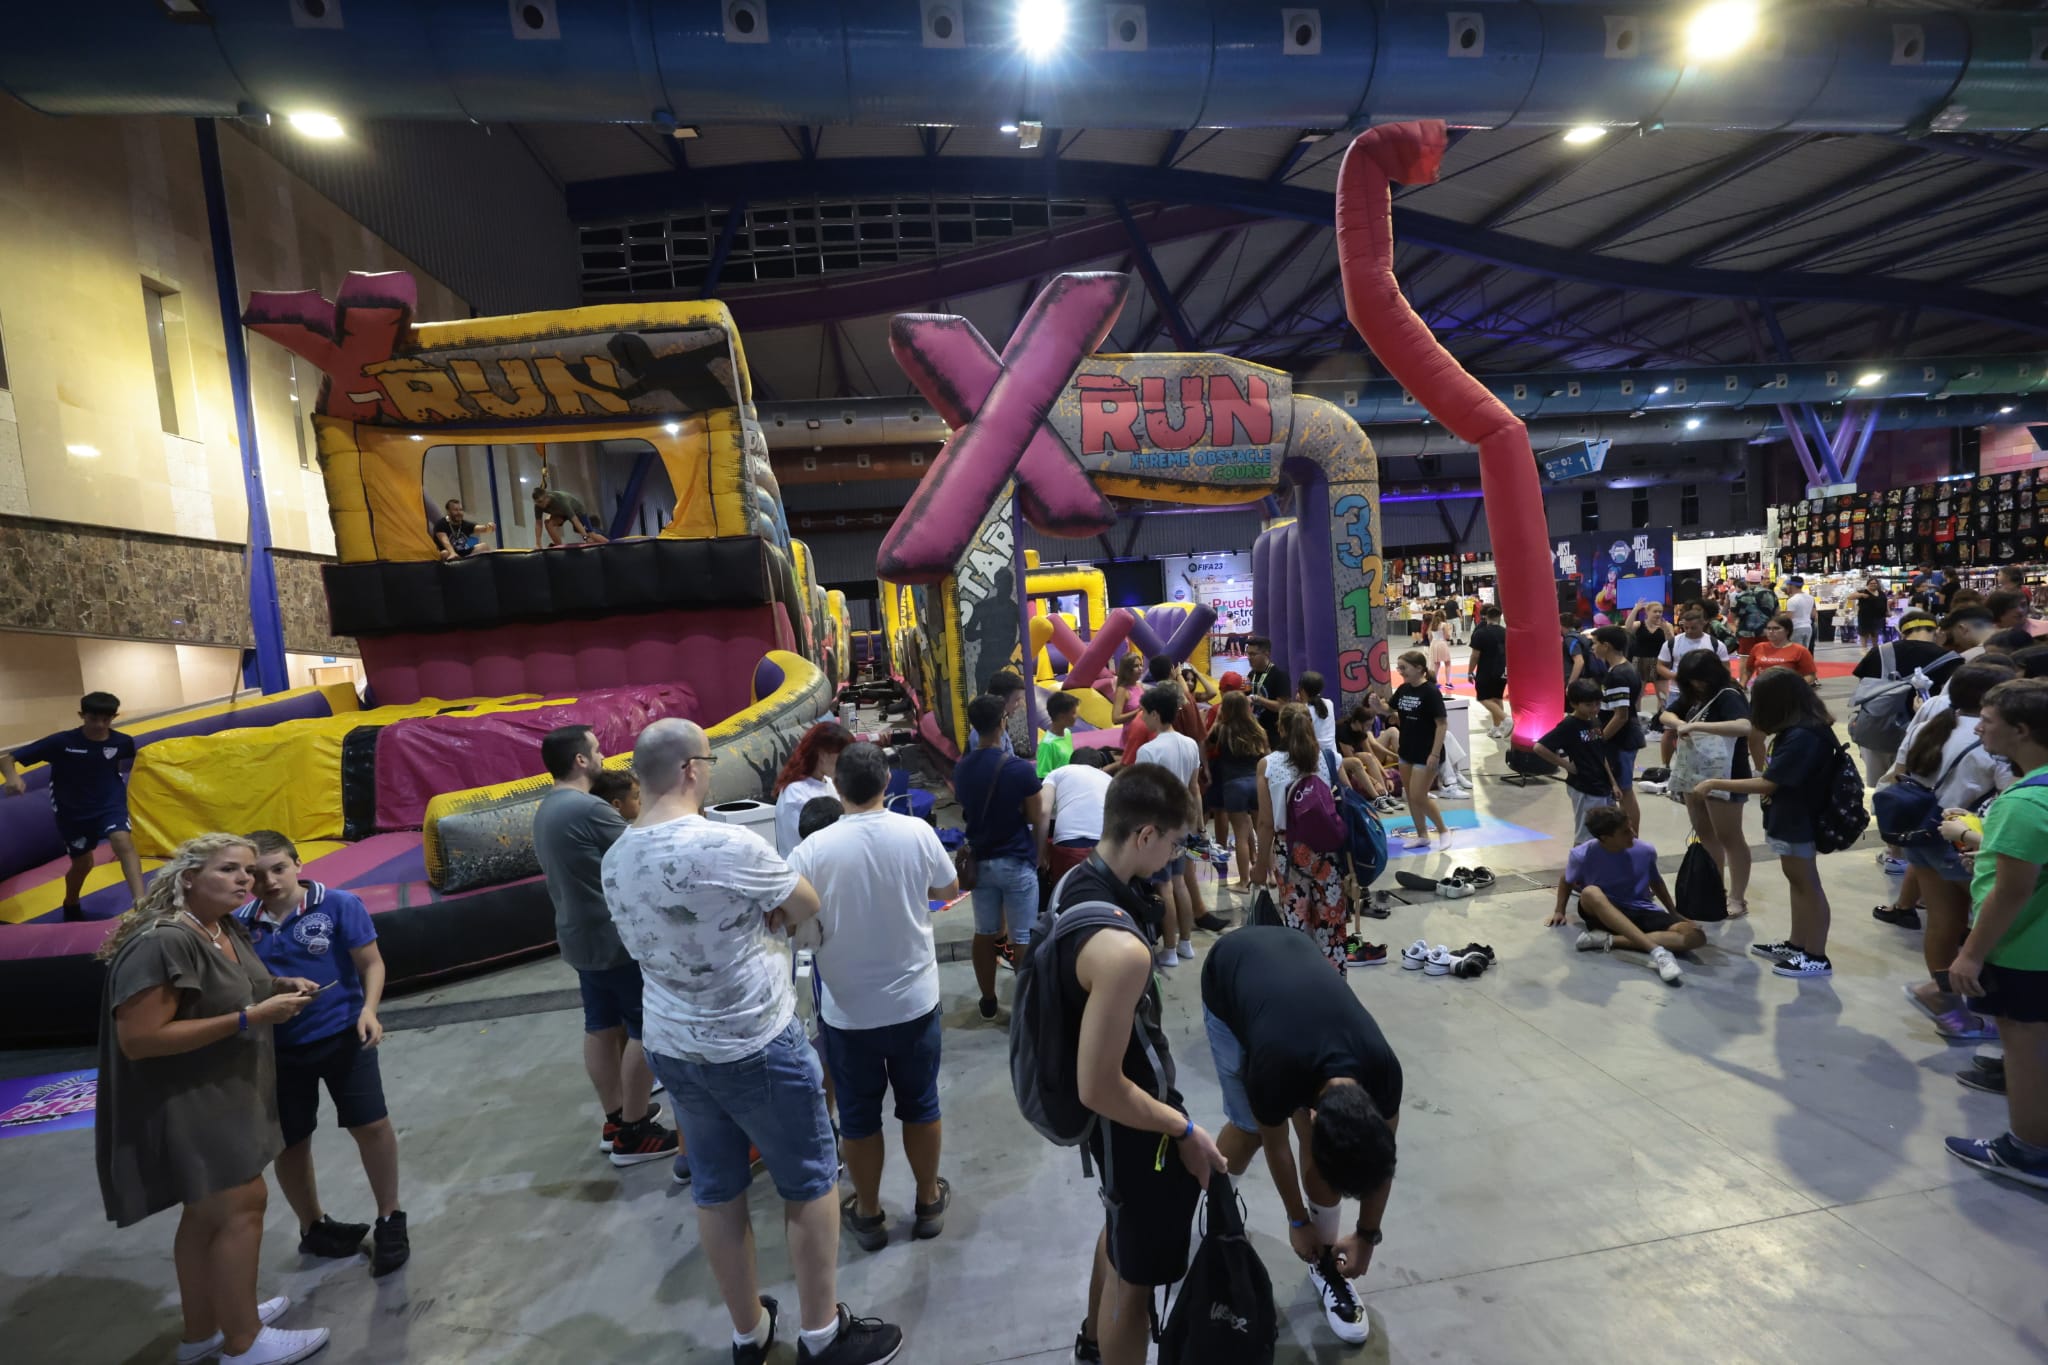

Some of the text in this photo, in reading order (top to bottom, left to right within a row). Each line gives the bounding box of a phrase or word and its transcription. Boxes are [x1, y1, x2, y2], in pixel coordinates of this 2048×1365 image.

[1071, 373, 1273, 456] RUN
[1129, 449, 1272, 469] XTREME OBSTACLE
[1213, 464, 1272, 480] COURSE
[1334, 494, 1373, 569] 3
[1556, 540, 1570, 557] JUST
[1632, 534, 1648, 551] JUST
[1559, 553, 1577, 569] DANCE
[1634, 547, 1656, 563] DANCE
[1361, 553, 1385, 609] 2
[1341, 586, 1373, 637] 1
[1337, 639, 1391, 693] GO
